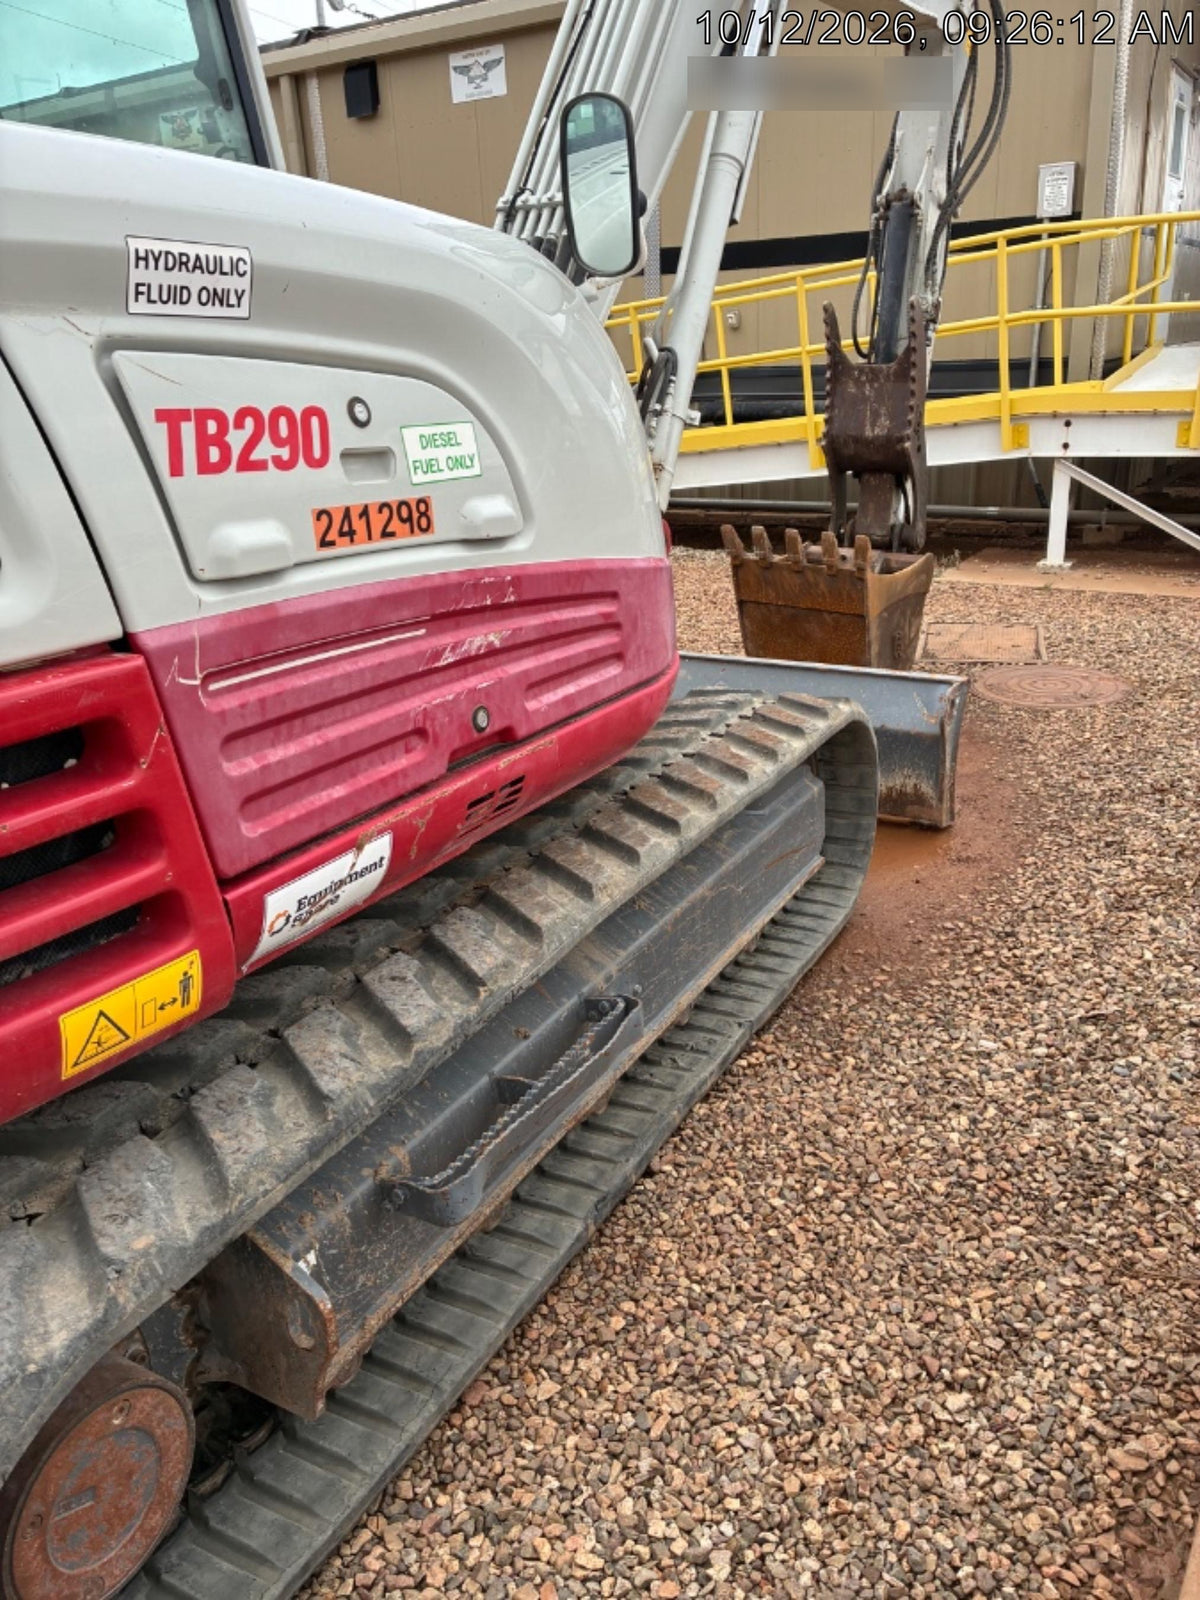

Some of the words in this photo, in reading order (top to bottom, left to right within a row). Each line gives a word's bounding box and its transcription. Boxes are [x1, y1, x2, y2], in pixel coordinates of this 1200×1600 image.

[134, 248, 248, 278] HYDRAULIC
[134, 282, 192, 305] FLUID
[197, 286, 246, 309] ONLY
[154, 405, 331, 478] TB290
[418, 431, 462, 450] DIESEL
[412, 457, 446, 475] FUEL
[448, 453, 476, 470] ONLY
[315, 497, 432, 548] 241298
[296, 856, 385, 913] Equipment
